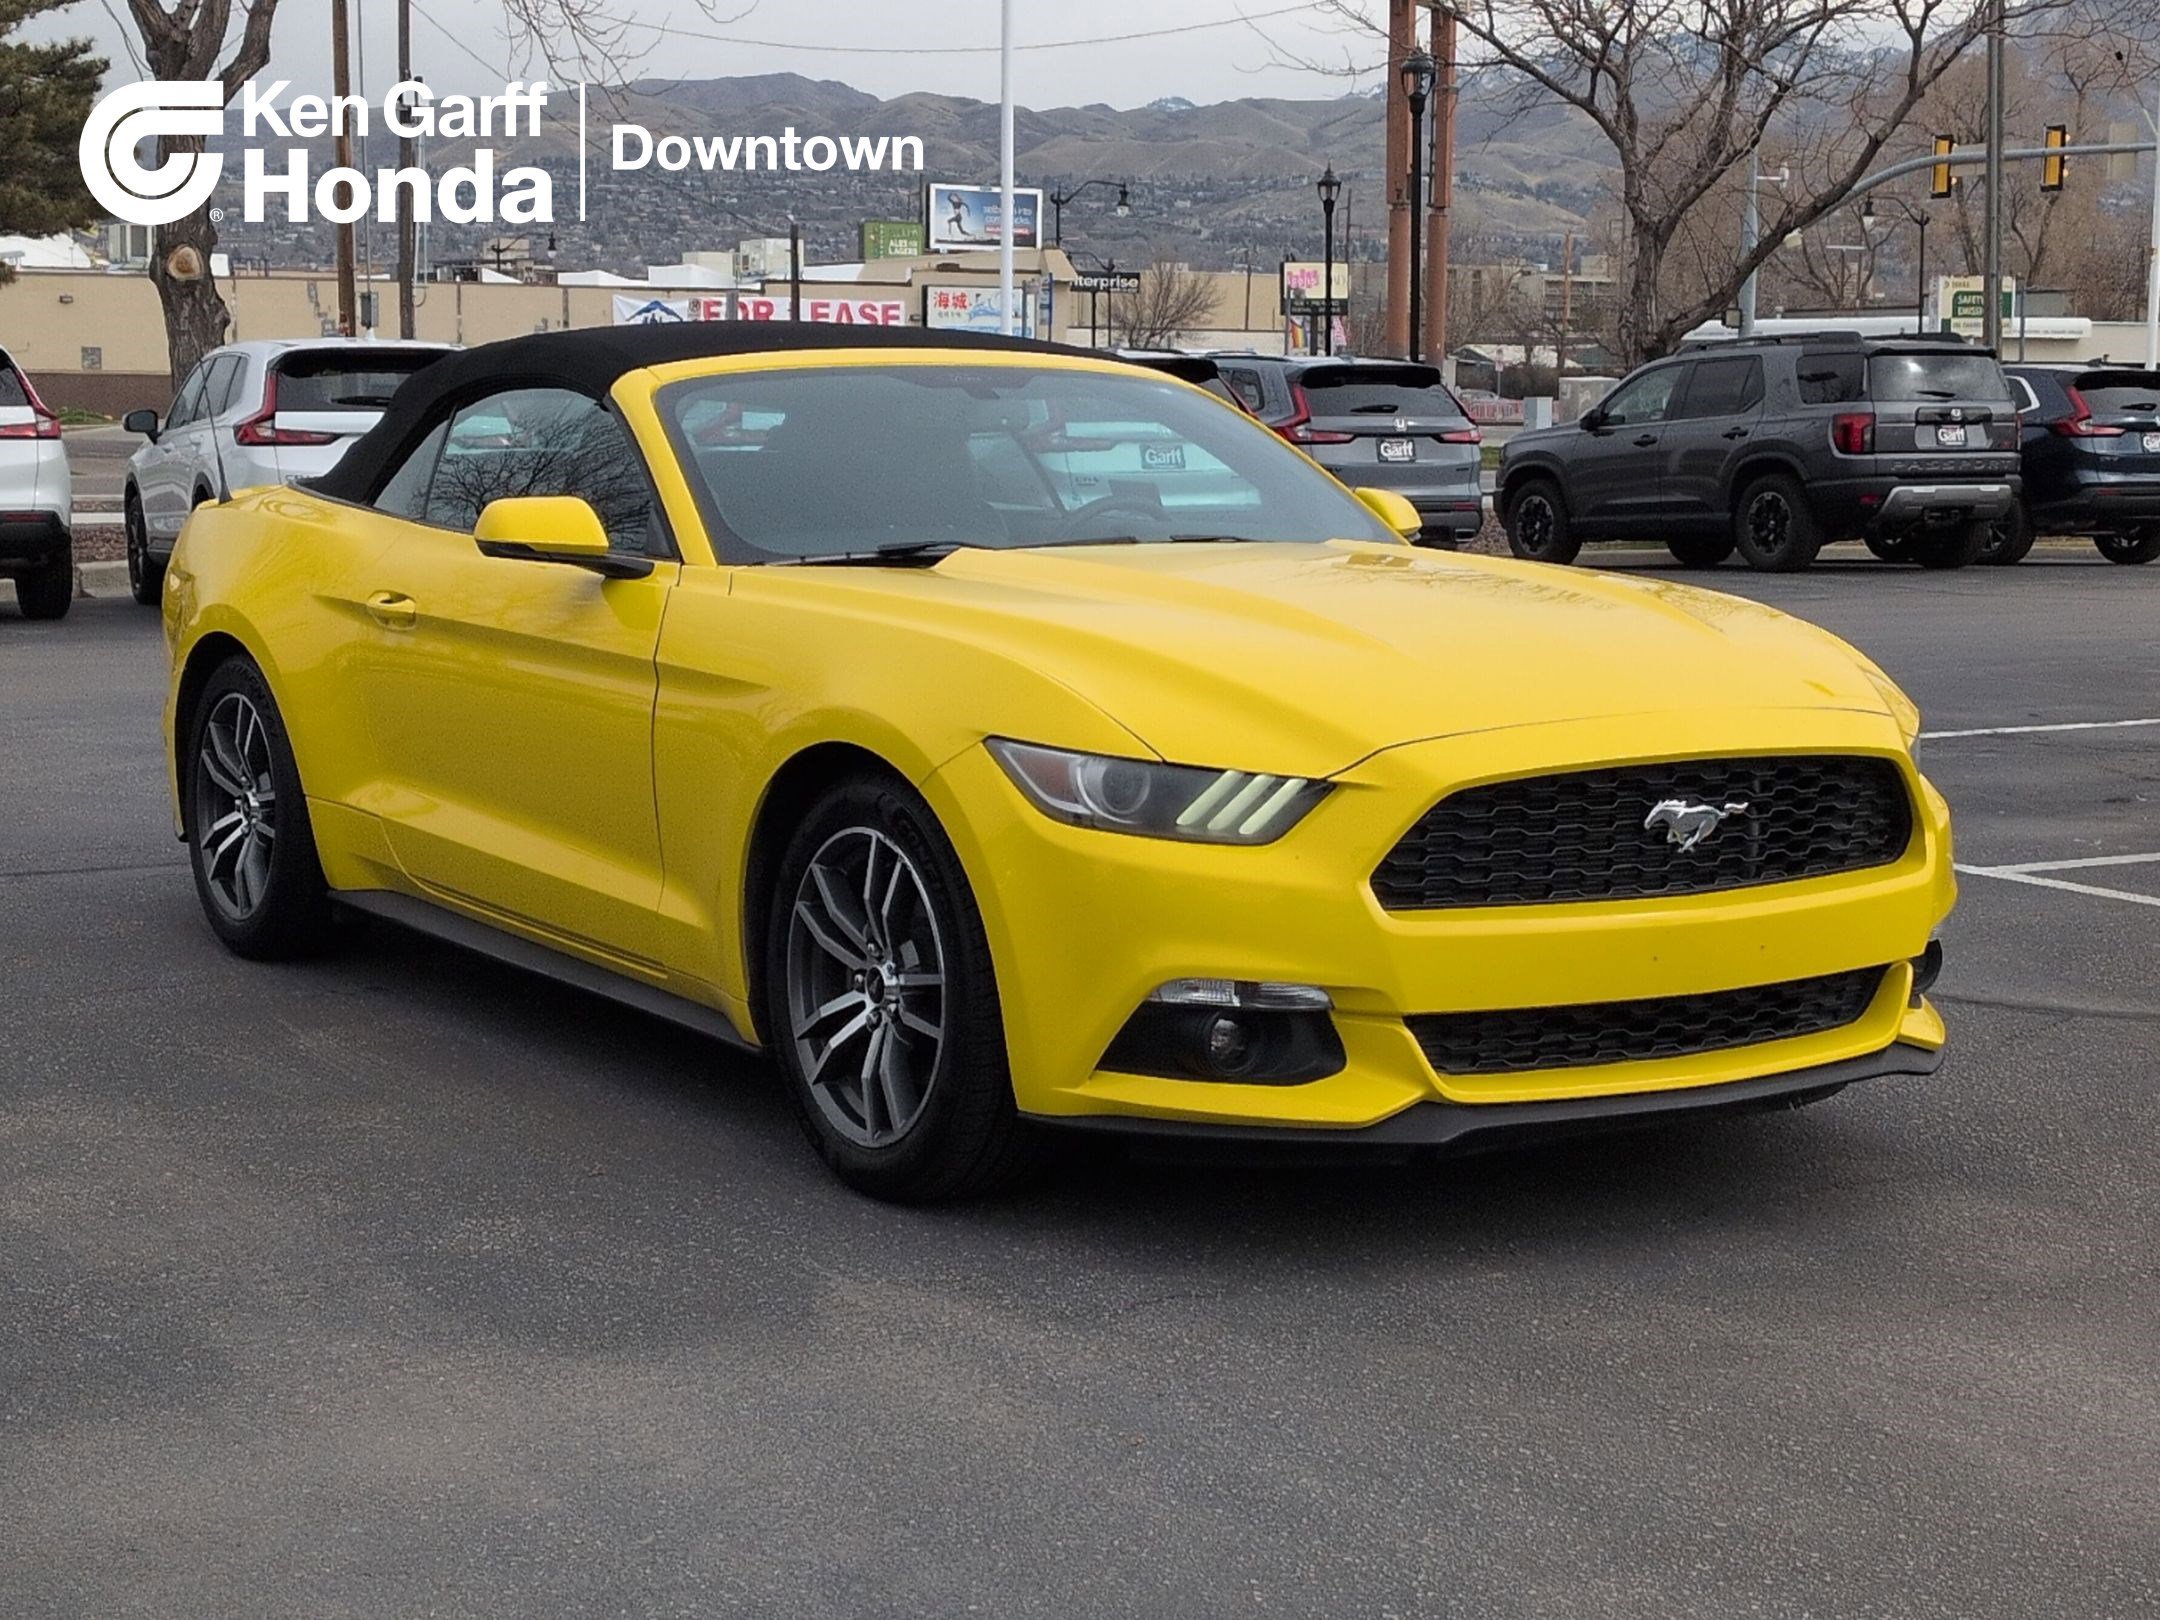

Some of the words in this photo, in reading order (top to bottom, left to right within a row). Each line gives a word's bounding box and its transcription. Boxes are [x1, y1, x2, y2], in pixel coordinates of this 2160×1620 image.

[1070, 274, 1139, 290] nterprise
[810, 301, 901, 325] EASE
[1145, 448, 1182, 464] Garff
[1380, 440, 1414, 456] Garff
[1891, 460, 2012, 471] PASSPORT
